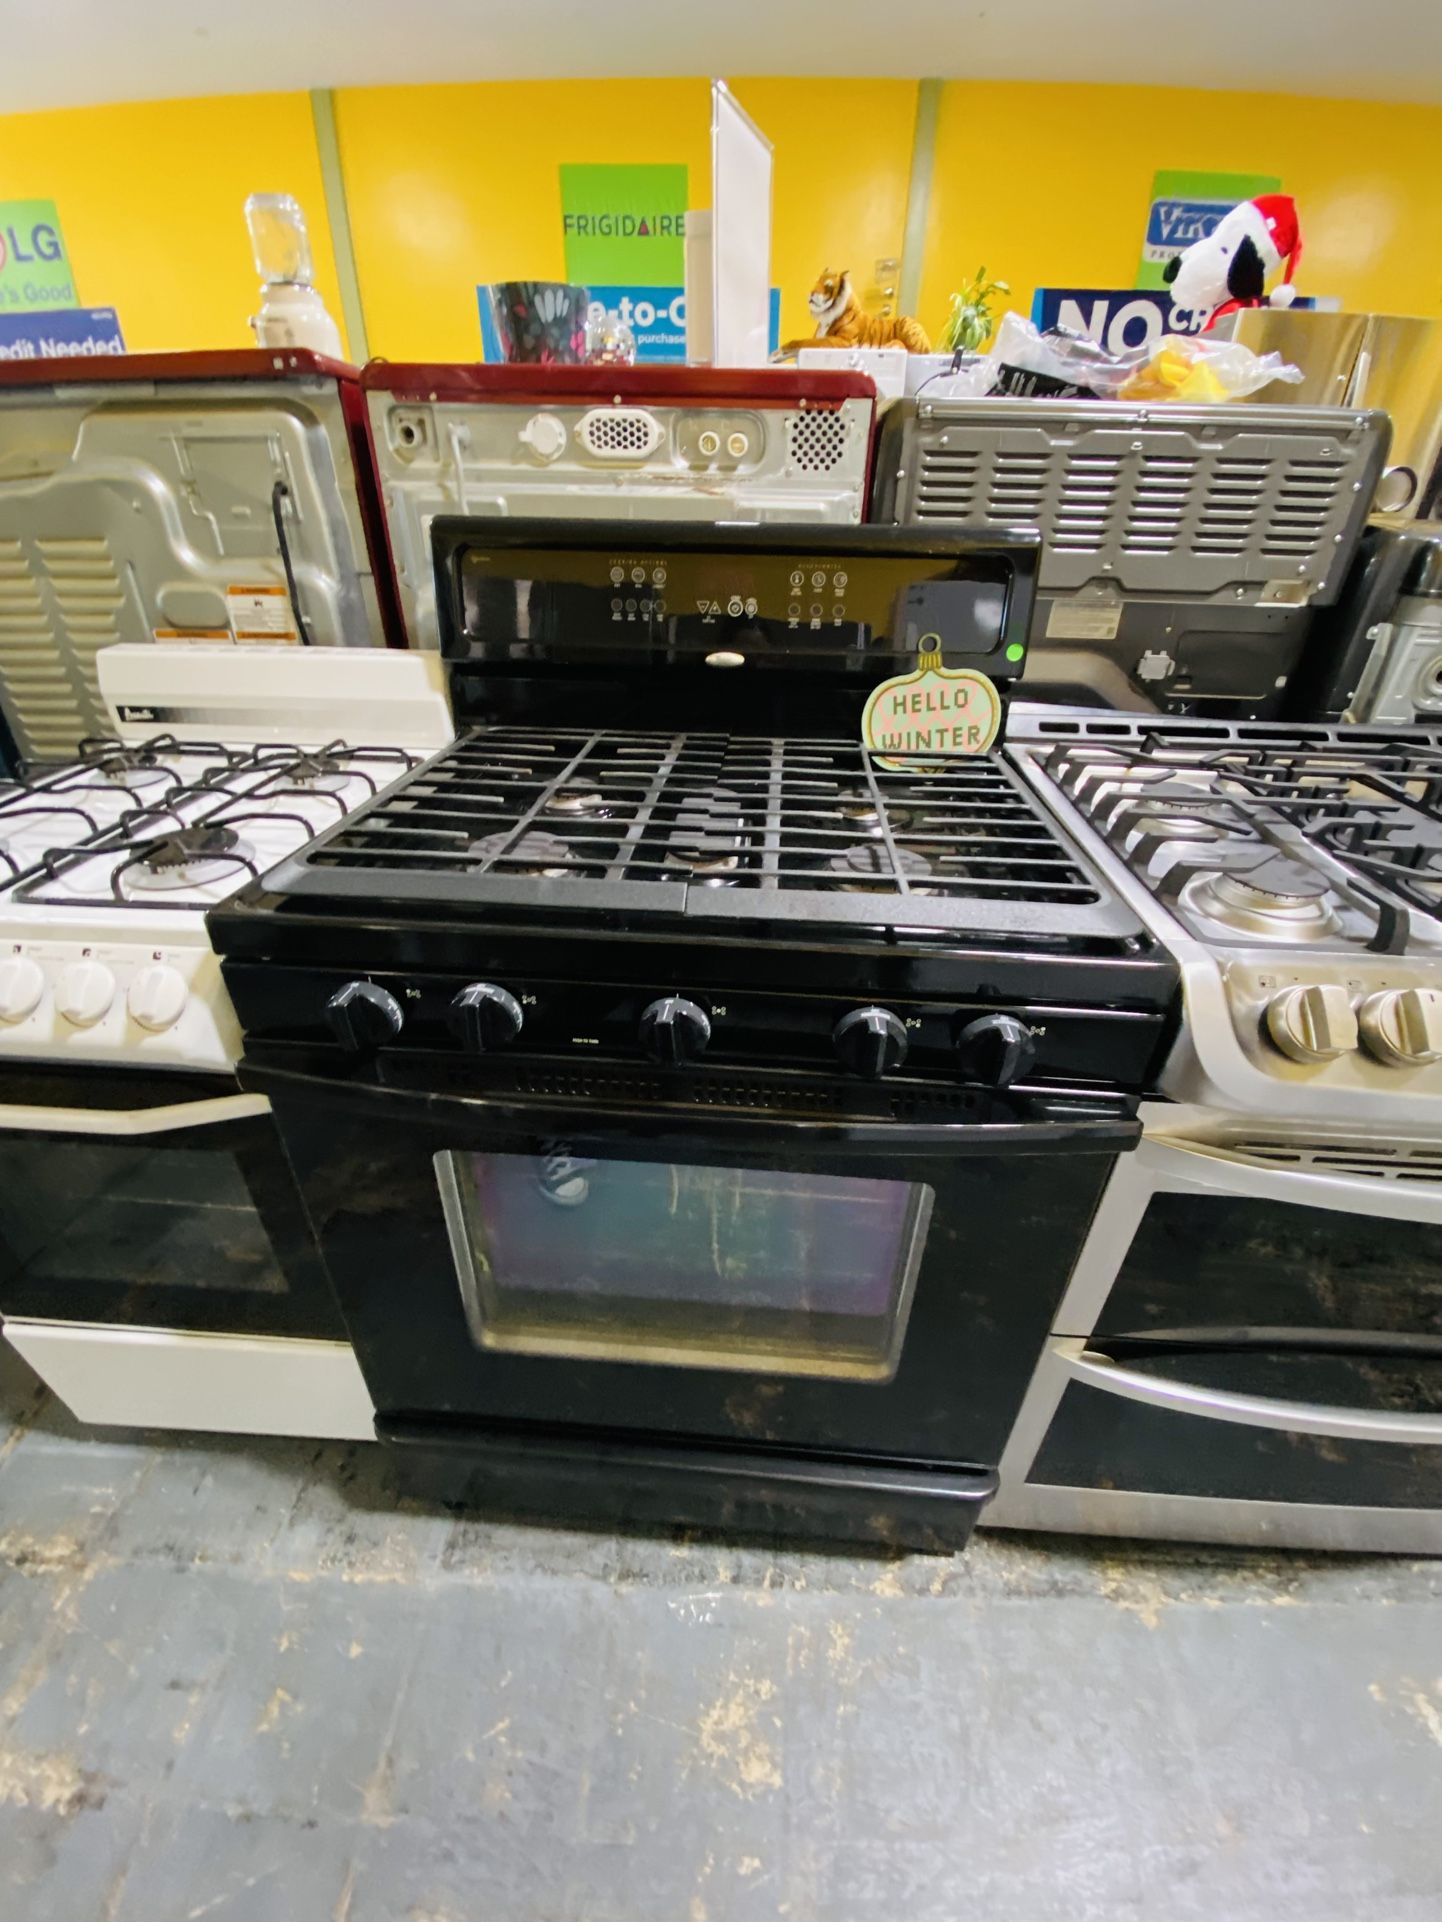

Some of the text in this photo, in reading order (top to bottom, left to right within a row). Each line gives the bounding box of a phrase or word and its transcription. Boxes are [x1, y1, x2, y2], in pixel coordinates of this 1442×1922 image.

[563, 214, 686, 237] FRIGIDAIRE
[7, 223, 62, 262] LG
[23, 282, 73, 304] Good
[1057, 299, 1163, 355] NO
[39, 334, 125, 359] Needed
[893, 688, 969, 715] HELLO
[881, 725, 981, 750] WINTER
